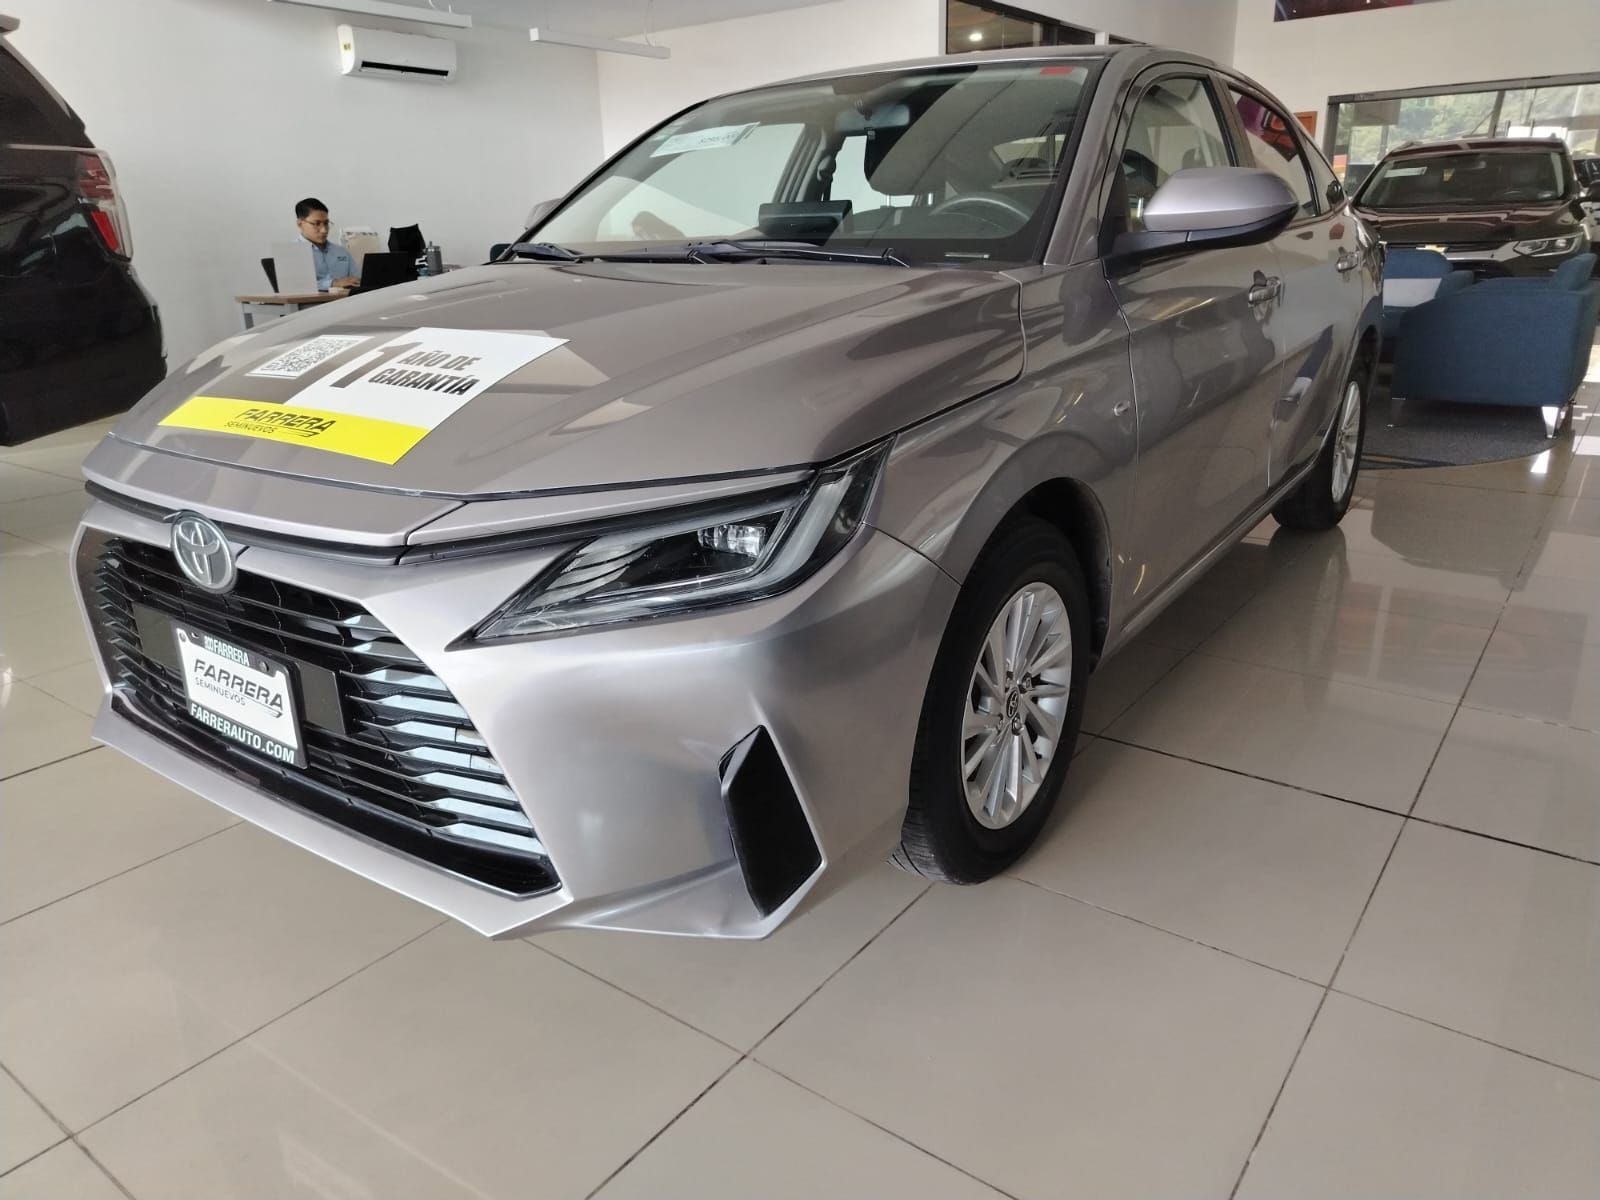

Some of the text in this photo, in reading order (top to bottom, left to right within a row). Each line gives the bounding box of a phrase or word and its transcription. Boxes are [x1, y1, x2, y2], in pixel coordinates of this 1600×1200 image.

[330, 342, 423, 388] 1
[397, 350, 482, 371] AÑO DE
[368, 368, 480, 395] GARANTÍA
[235, 408, 336, 432] FARRERA
[213, 639, 250, 667] FARRERA
[194, 659, 284, 711] FARRERA
[195, 677, 246, 706] SEMINUEVOS
[190, 703, 295, 765] FARRERAUTO.COM
